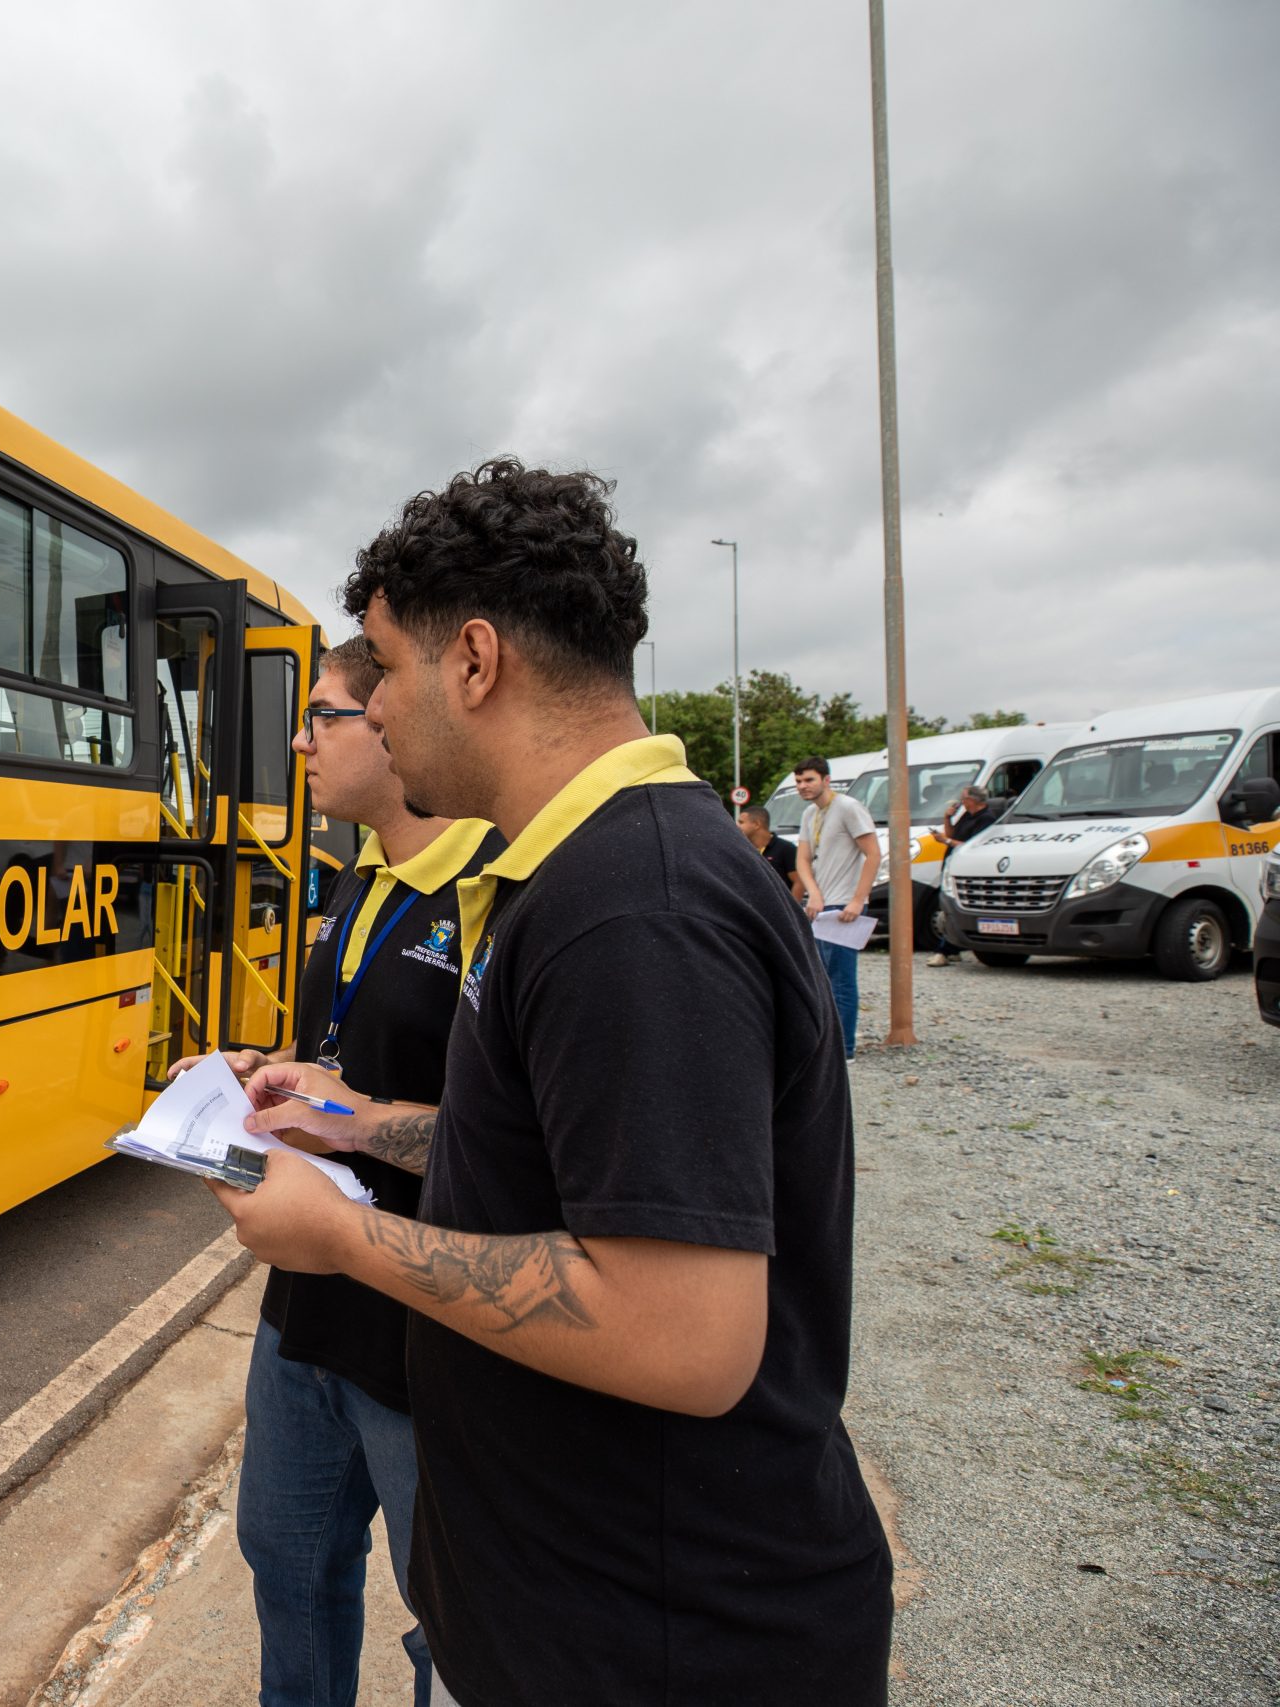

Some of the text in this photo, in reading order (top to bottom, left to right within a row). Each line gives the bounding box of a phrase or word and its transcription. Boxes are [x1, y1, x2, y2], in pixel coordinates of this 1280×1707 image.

[734, 790, 746, 799] 40
[983, 833, 1082, 846] ESCOLAR
[1231, 841, 1270, 856] 81366
